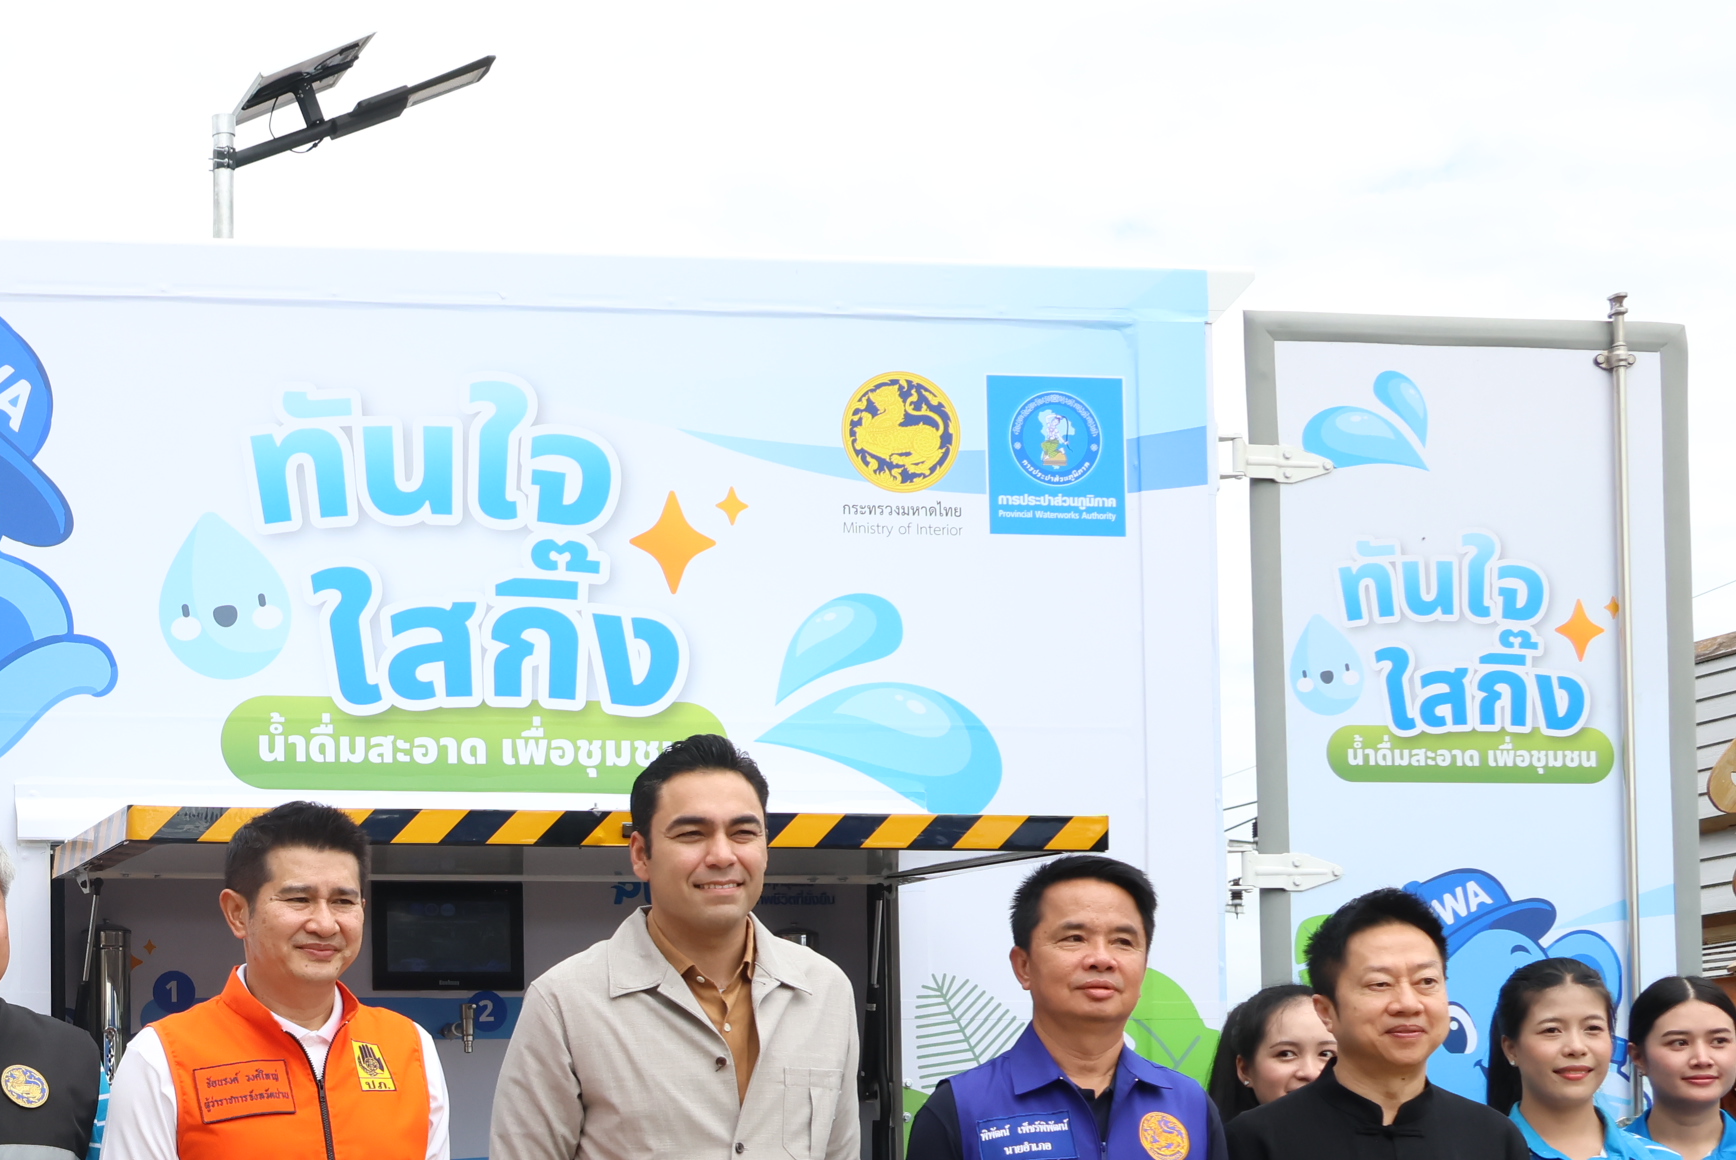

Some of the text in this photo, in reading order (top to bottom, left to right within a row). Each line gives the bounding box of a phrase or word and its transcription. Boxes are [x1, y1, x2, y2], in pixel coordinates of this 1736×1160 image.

[250, 380, 612, 527] ทันใจ
[842, 500, 963, 518] กระทรวงมหาดไทย
[997, 493, 1117, 510] การประปาส่วนภูมิภาค
[998, 509, 1117, 522] Provincial Waterworks Authority
[843, 521, 963, 538] Ministry of Interior
[1337, 532, 1547, 623] ทันใจ
[310, 538, 681, 708] ใสกิ๊ง
[1373, 628, 1586, 732] ใสกิ๊ง
[257, 712, 674, 779] น้ำดื่มสะอาด เพื่อชุมช
[1347, 734, 1598, 775] น้ำดื่มสะอาด เพื่อชุมชน
[1430, 880, 1494, 925] WA
[165, 980, 178, 1003] 1
[478, 999, 495, 1022] 2
[980, 1124, 1011, 1142] พิพัฒน์
[1003, 1141, 1053, 1155] นายอำเภอ
